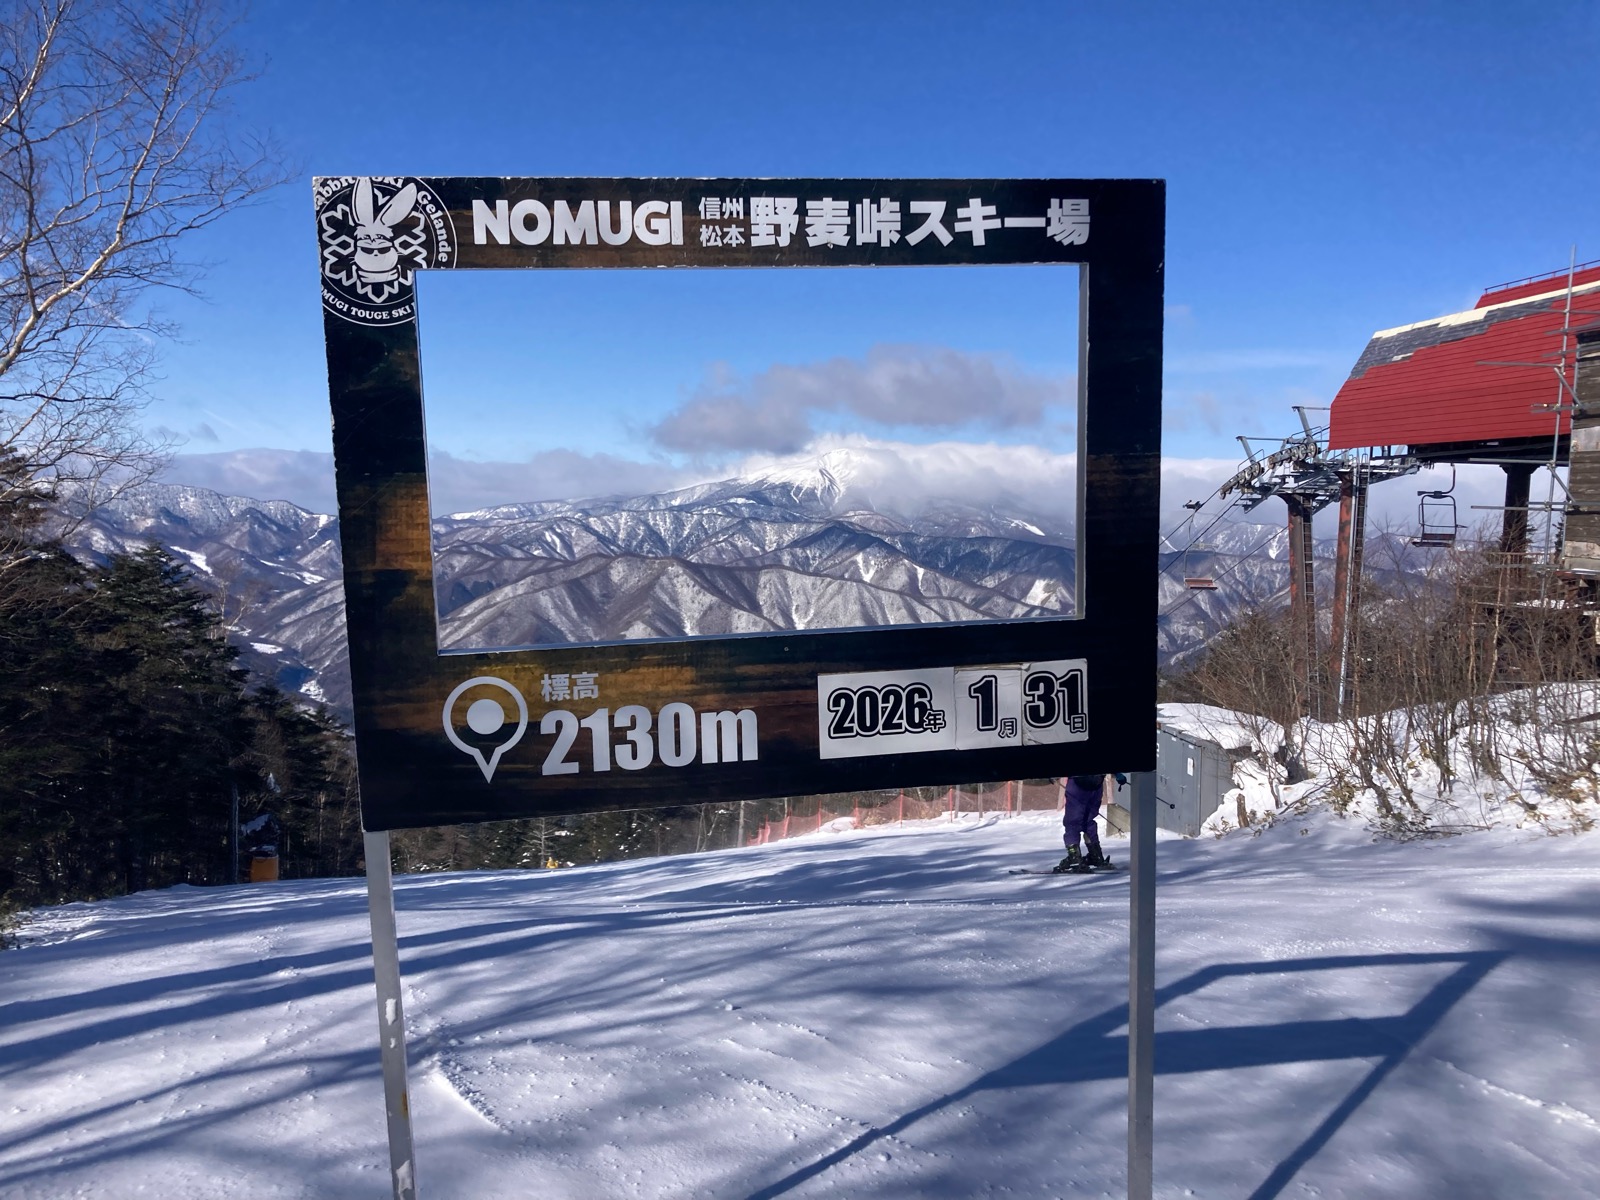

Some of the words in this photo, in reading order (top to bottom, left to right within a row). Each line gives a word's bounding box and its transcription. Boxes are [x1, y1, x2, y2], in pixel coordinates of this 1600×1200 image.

[315, 177, 355, 210] abbit
[417, 191, 452, 262] Gelande
[472, 199, 684, 246] NOMUGI
[699, 197, 744, 220] 信州
[750, 197, 1091, 248] 野麦峠スキー場
[700, 224, 746, 248] 松本
[321, 286, 349, 311] MUGI
[350, 307, 390, 319] TOUGE
[391, 305, 412, 318] SKI
[540, 672, 599, 702] 標高
[827, 682, 946, 739] 2026年
[969, 674, 1017, 738] 1月
[1023, 669, 1087, 733] 31日
[540, 702, 759, 776] 2130m
